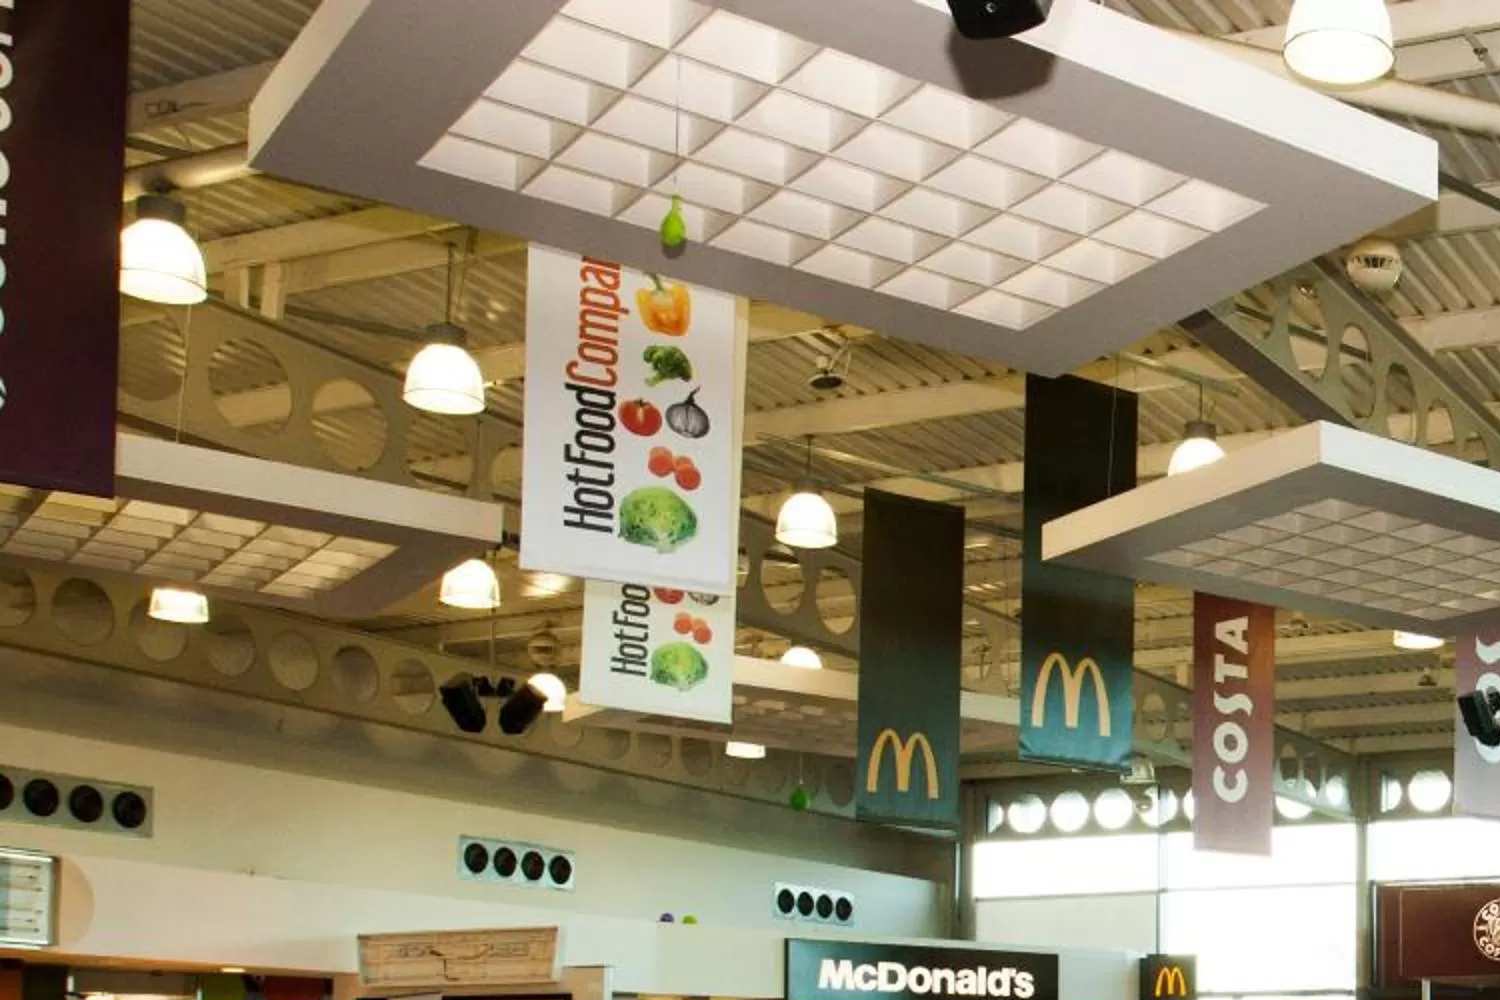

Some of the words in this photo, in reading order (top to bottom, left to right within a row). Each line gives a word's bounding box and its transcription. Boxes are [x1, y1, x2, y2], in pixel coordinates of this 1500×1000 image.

[563, 256, 630, 534] HotFoodCompa
[610, 583, 651, 677] HotFoo
[1031, 652, 1111, 737] M
[1213, 616, 1254, 803] COSTA
[867, 728, 939, 800] M
[818, 958, 1036, 999] McDonald's
[1155, 966, 1188, 997] M
